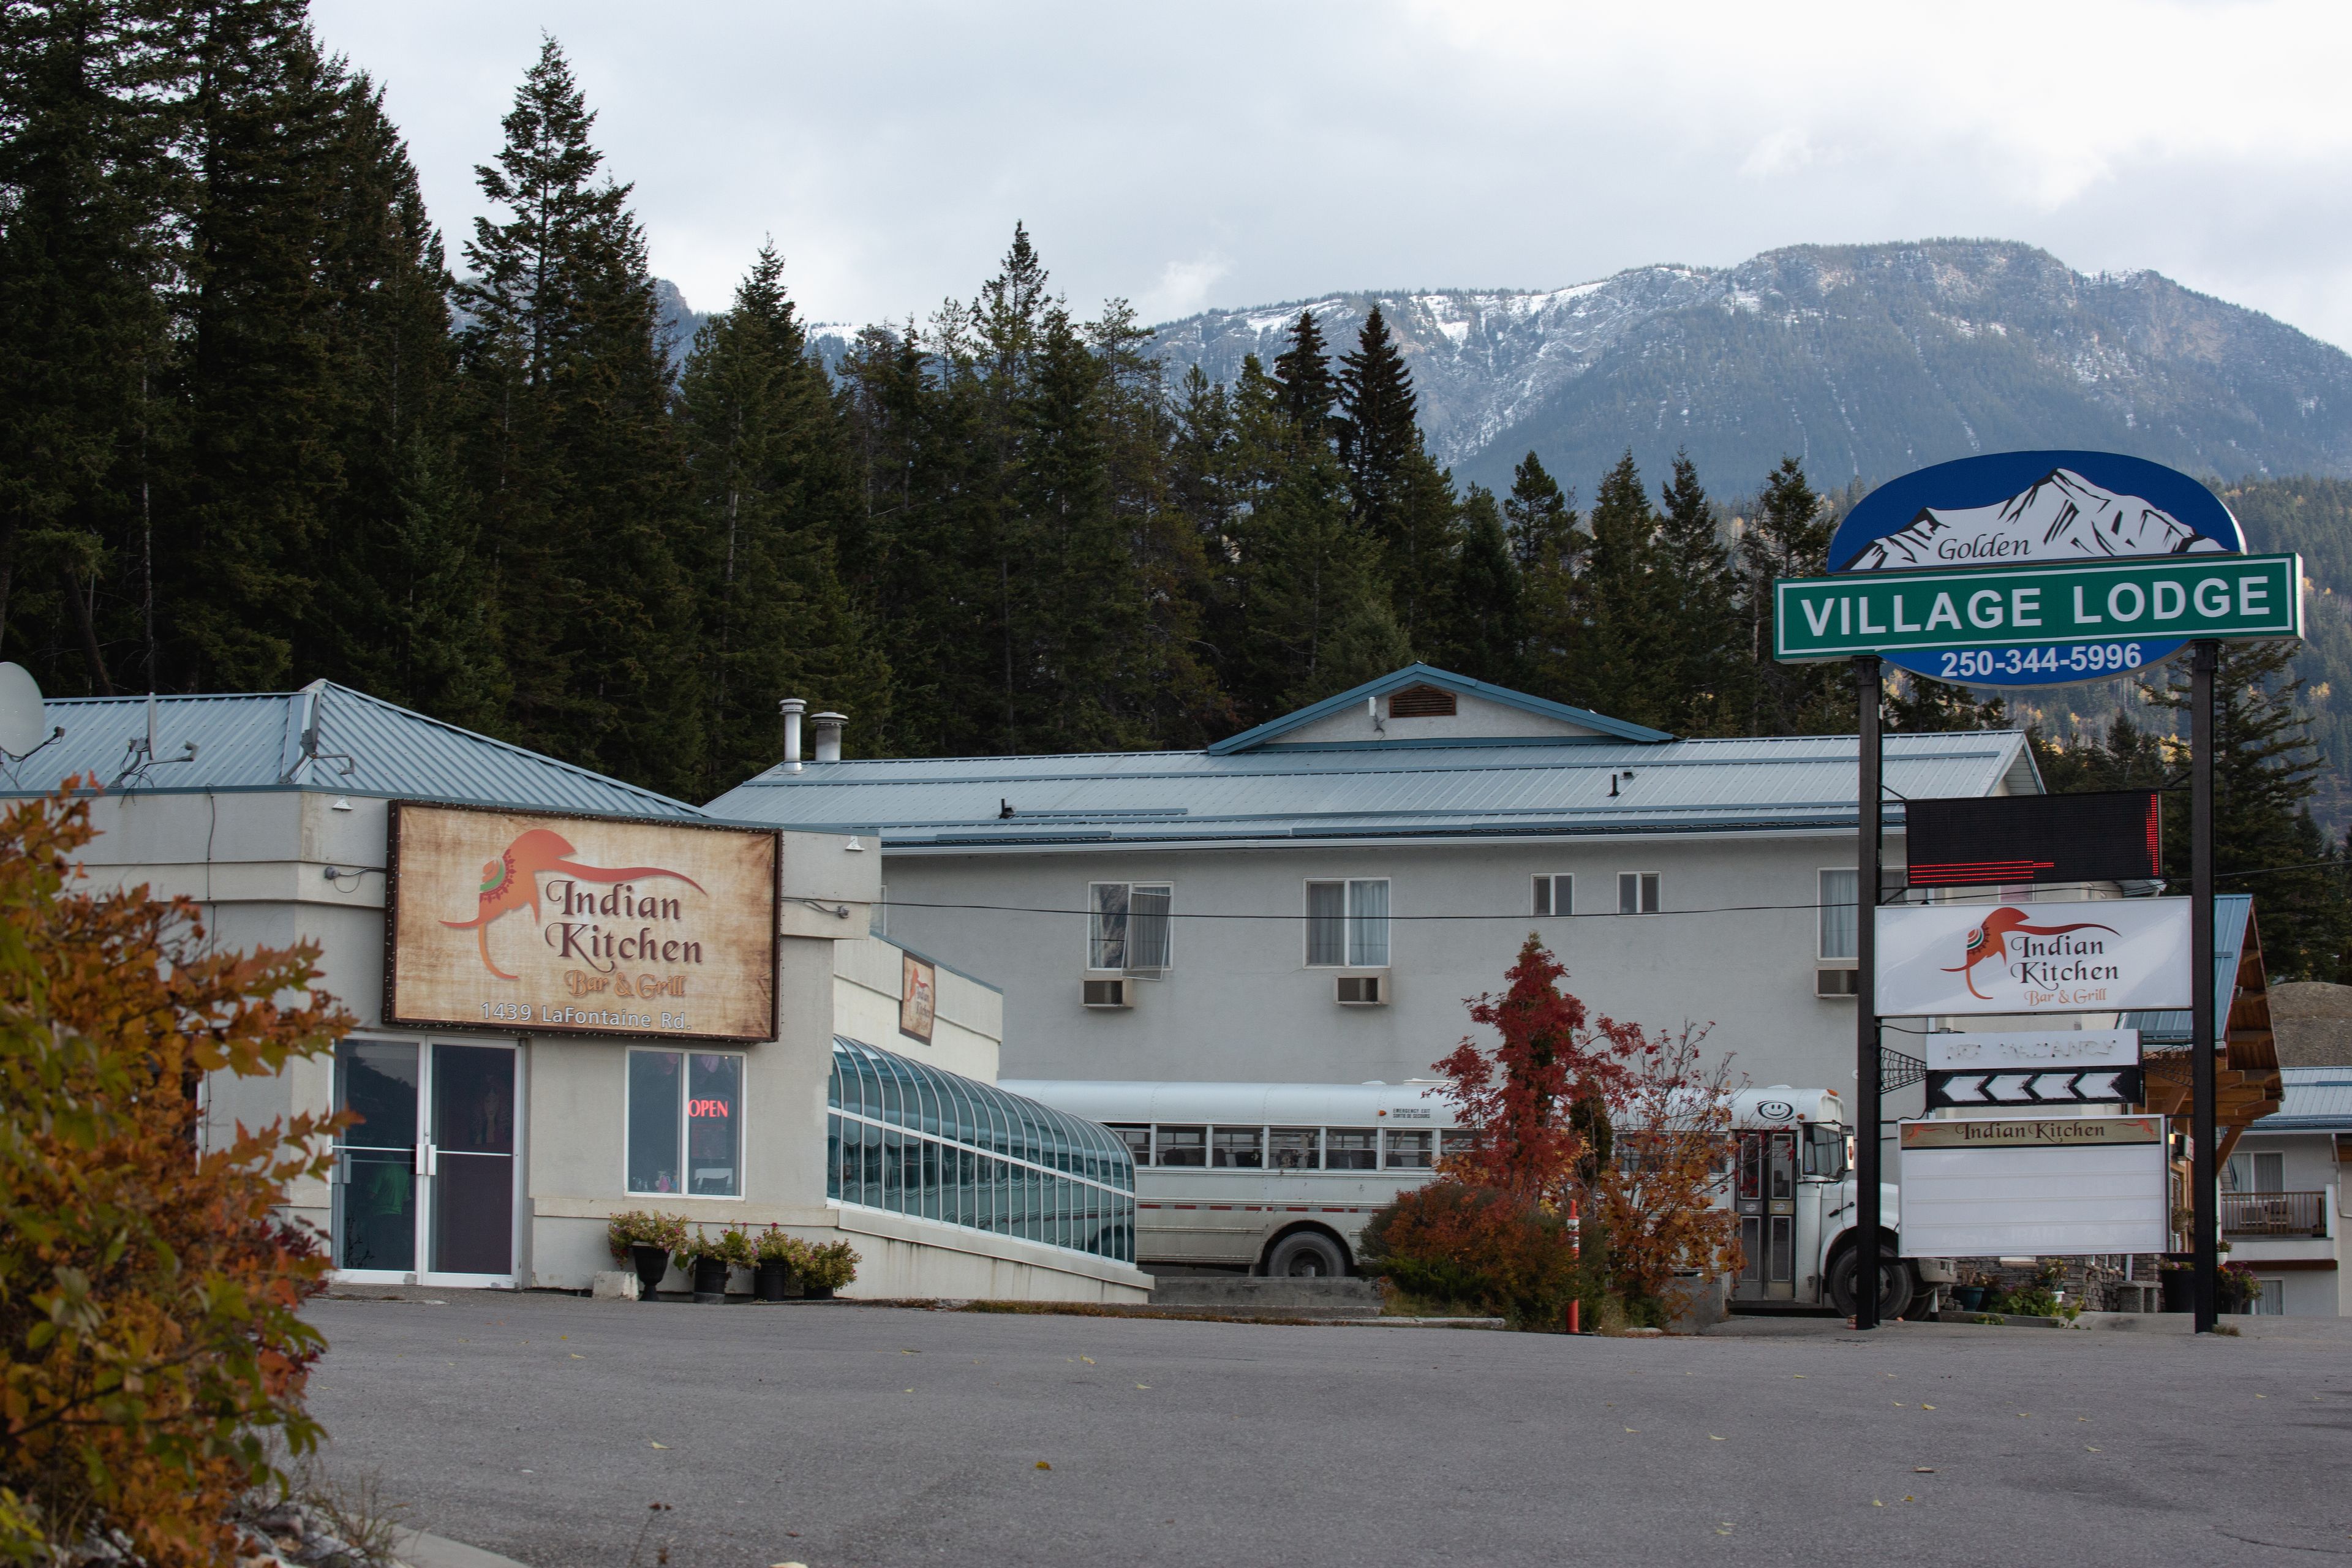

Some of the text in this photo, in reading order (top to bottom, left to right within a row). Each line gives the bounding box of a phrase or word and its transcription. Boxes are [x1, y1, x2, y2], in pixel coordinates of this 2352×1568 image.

[1938, 532, 2032, 560] Golden
[1800, 576, 2271, 637] VILLAGE LODGE
[1940, 643, 2142, 677] 250-344-5996
[546, 880, 681, 920] Indian
[545, 922, 703, 973] Kitchen
[2010, 935, 2104, 958] Indian
[563, 969, 686, 999] Bar & Grill
[2010, 960, 2119, 991] Kitchen
[2024, 988, 2108, 1006] Bar & Grill
[481, 1002, 692, 1030] 1439 LaFontaine Rd.
[688, 1099, 728, 1117] OPEN
[1955, 1121, 2105, 1144] Indian Kitchen
